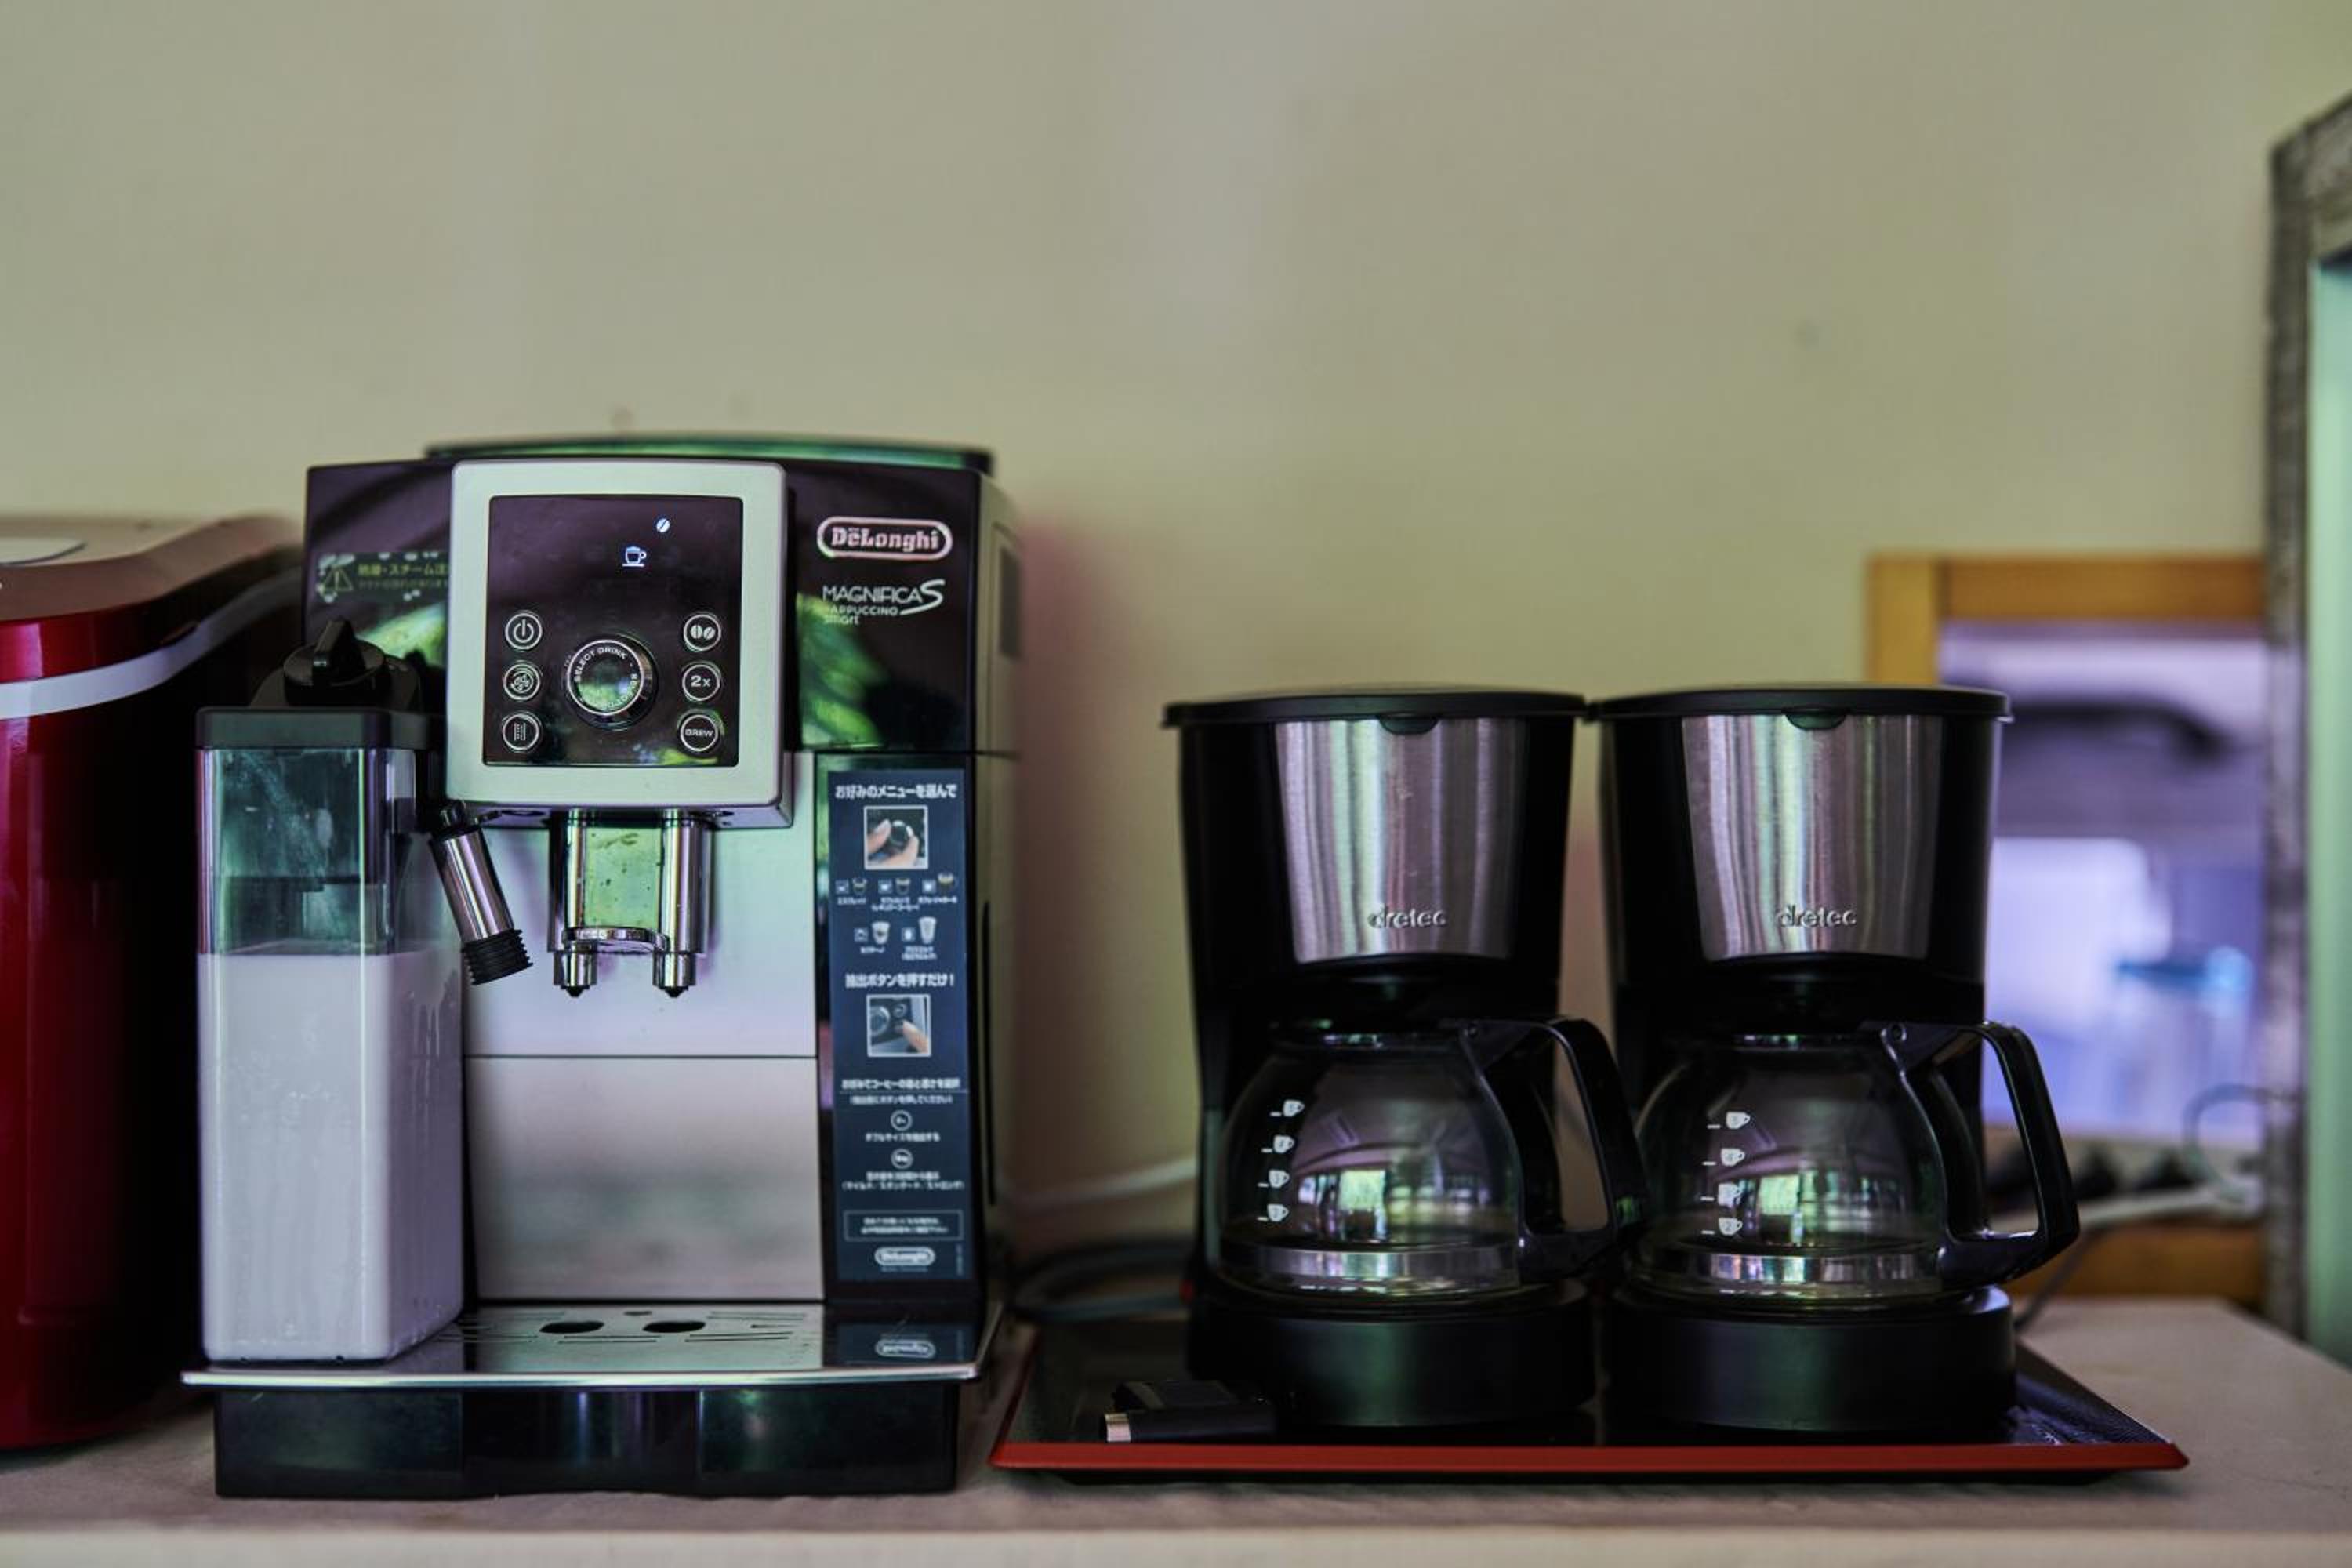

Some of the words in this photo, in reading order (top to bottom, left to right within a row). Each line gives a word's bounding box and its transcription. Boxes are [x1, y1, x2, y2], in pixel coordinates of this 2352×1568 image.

[822, 585, 923, 603] MAGNIFICA
[596, 647, 627, 659] DRINK
[684, 728, 714, 738] BREW
[835, 784, 957, 799] お好みのメニューを選んで
[1367, 905, 1448, 928] dretec
[1777, 905, 1857, 928] dretec
